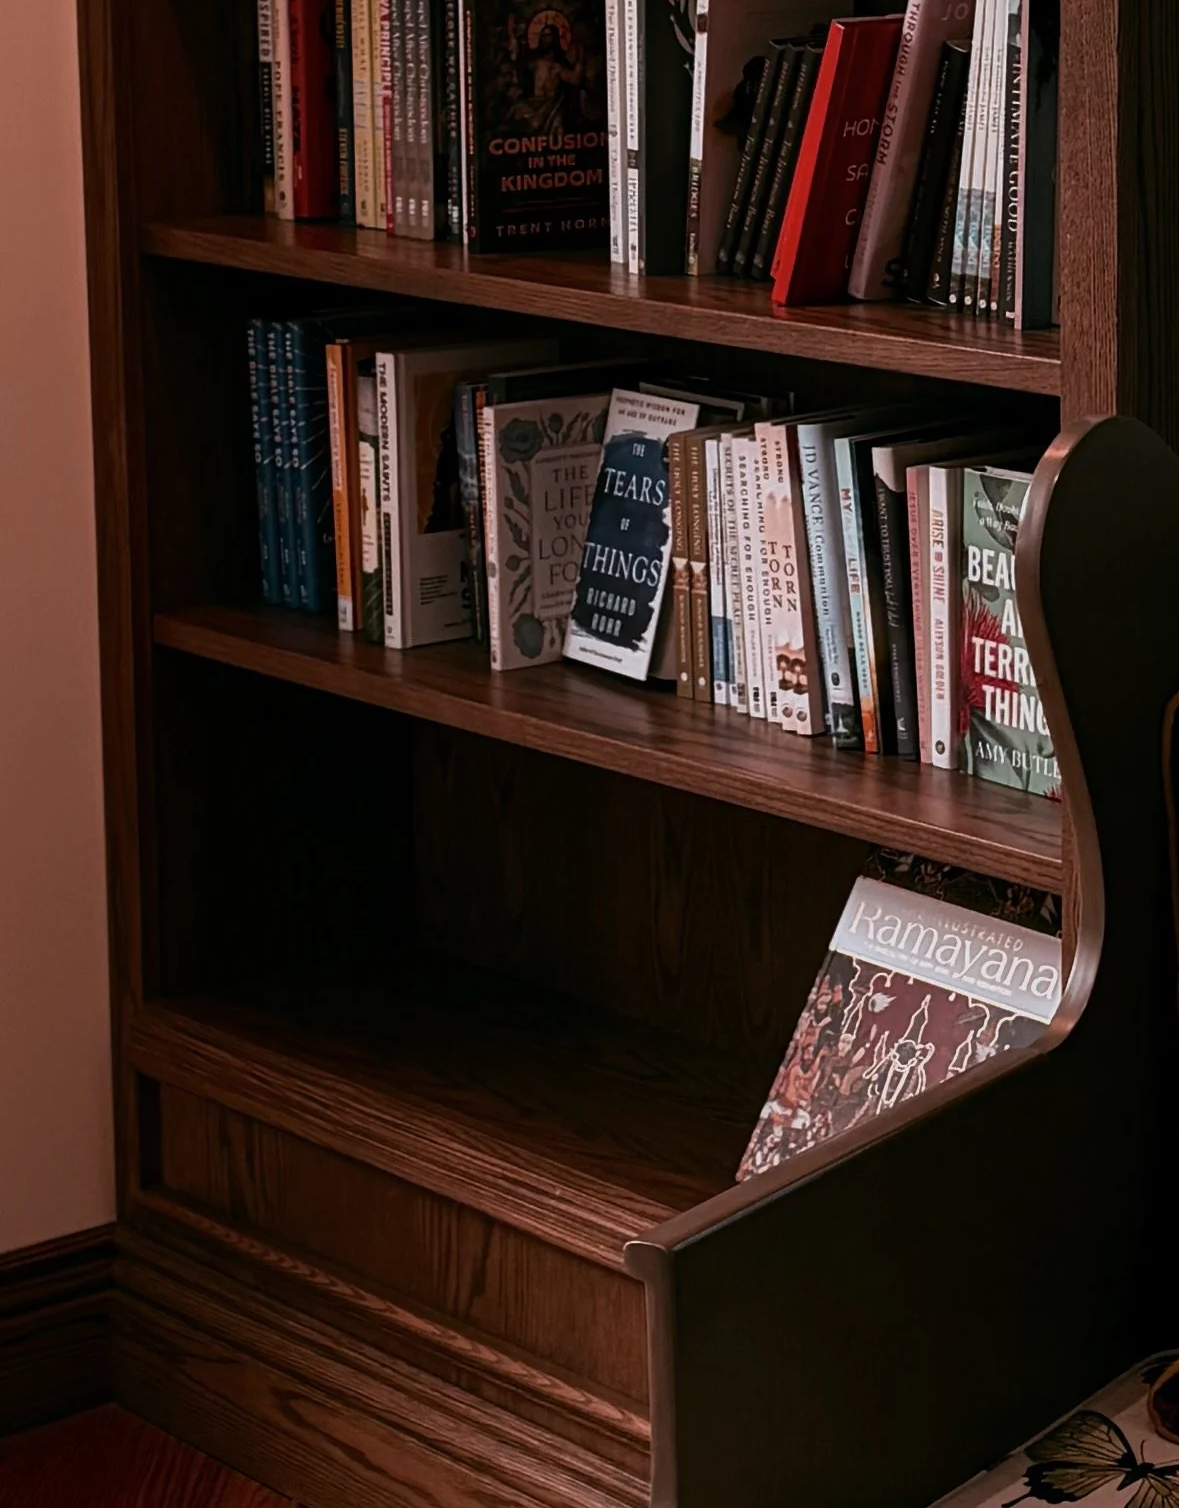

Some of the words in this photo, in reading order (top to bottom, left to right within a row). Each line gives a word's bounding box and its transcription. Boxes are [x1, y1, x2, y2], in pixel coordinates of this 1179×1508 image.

[391, 29, 402, 61] After
[405, 32, 415, 63] After
[418, 33, 429, 65] After
[894, 1, 921, 76] THROUGH
[380, 19, 393, 99] PRINCIPLE
[275, 60, 283, 106] POPE
[393, 61, 403, 141] Christendom
[406, 63, 416, 142] Christendom
[418, 66, 430, 144] Christendom
[277, 110, 286, 183] FRANCIS
[876, 101, 899, 165] STORM
[528, 156, 545, 168] IN
[547, 154, 576, 168] THE
[500, 169, 603, 193] KINGDOM
[690, 166, 699, 218] BRIDGES
[1007, 168, 1020, 232] GOOD
[495, 223, 553, 238] TRENT
[560, 216, 610, 233] HORN
[247, 329, 256, 355] THE
[267, 332, 277, 359] THE
[284, 332, 294, 359] THE
[248, 360, 258, 400] BIBLE
[269, 364, 279, 404] BIBLE
[286, 365, 296, 404] BIBLE
[378, 362, 387, 388] THE
[379, 391, 389, 449] MODERN
[672, 406, 686, 417] FOR
[253, 443, 261, 463] SO
[273, 448, 282, 467] SO
[290, 449, 299, 468] SO
[632, 443, 645, 458] THE
[671, 442, 680, 461] THE
[689, 446, 698, 465] THE
[760, 437, 769, 480] STRONG
[774, 440, 783, 483] STRONG
[802, 444, 816, 463] JD
[381, 455, 391, 501] SAINTS
[552, 464, 589, 484] THE
[603, 467, 666, 507] TEARS
[672, 466, 682, 494] HOLY
[689, 471, 700, 498] HOLY
[723, 446, 734, 494] SECRETS
[545, 483, 594, 513] LIFE
[726, 499, 735, 511] OF
[738, 455, 750, 529] SEARCHING
[754, 458, 765, 533] SEARCHING
[805, 469, 823, 525] VANCE
[876, 491, 887, 521] WANT
[907, 491, 916, 523] JESUS
[553, 514, 587, 534] YOU
[619, 517, 631, 531] OF
[672, 500, 685, 551] LONGING
[690, 503, 704, 555] LONGING
[727, 519, 736, 541] THE
[840, 488, 852, 513] MY
[847, 557, 860, 593] LIFE
[879, 524, 888, 536] TO
[909, 527, 918, 556] OVER
[931, 509, 944, 545] ARISE
[583, 541, 662, 588] THINGS
[728, 545, 739, 587] SECRET
[743, 535, 752, 560] FOR
[759, 539, 767, 563] FOR
[880, 538, 891, 567] TRUST
[745, 566, 755, 620] ENOUGH
[767, 541, 783, 608] TORN
[781, 544, 798, 612] TORN
[813, 534, 832, 615] Communion
[932, 565, 945, 603] SHINE
[586, 587, 637, 617] RICHARD
[731, 592, 741, 626] PLACE
[761, 570, 771, 625] ENOUGH
[911, 561, 922, 631] EVERYTHING
[591, 612, 622, 638] ROHR
[971, 636, 1036, 686] TERR
[982, 684, 1050, 737] THING
[975, 740, 1006, 767] AMY
[1011, 749, 1062, 781] BUTLE
[850, 900, 1059, 1000] Ramayana
